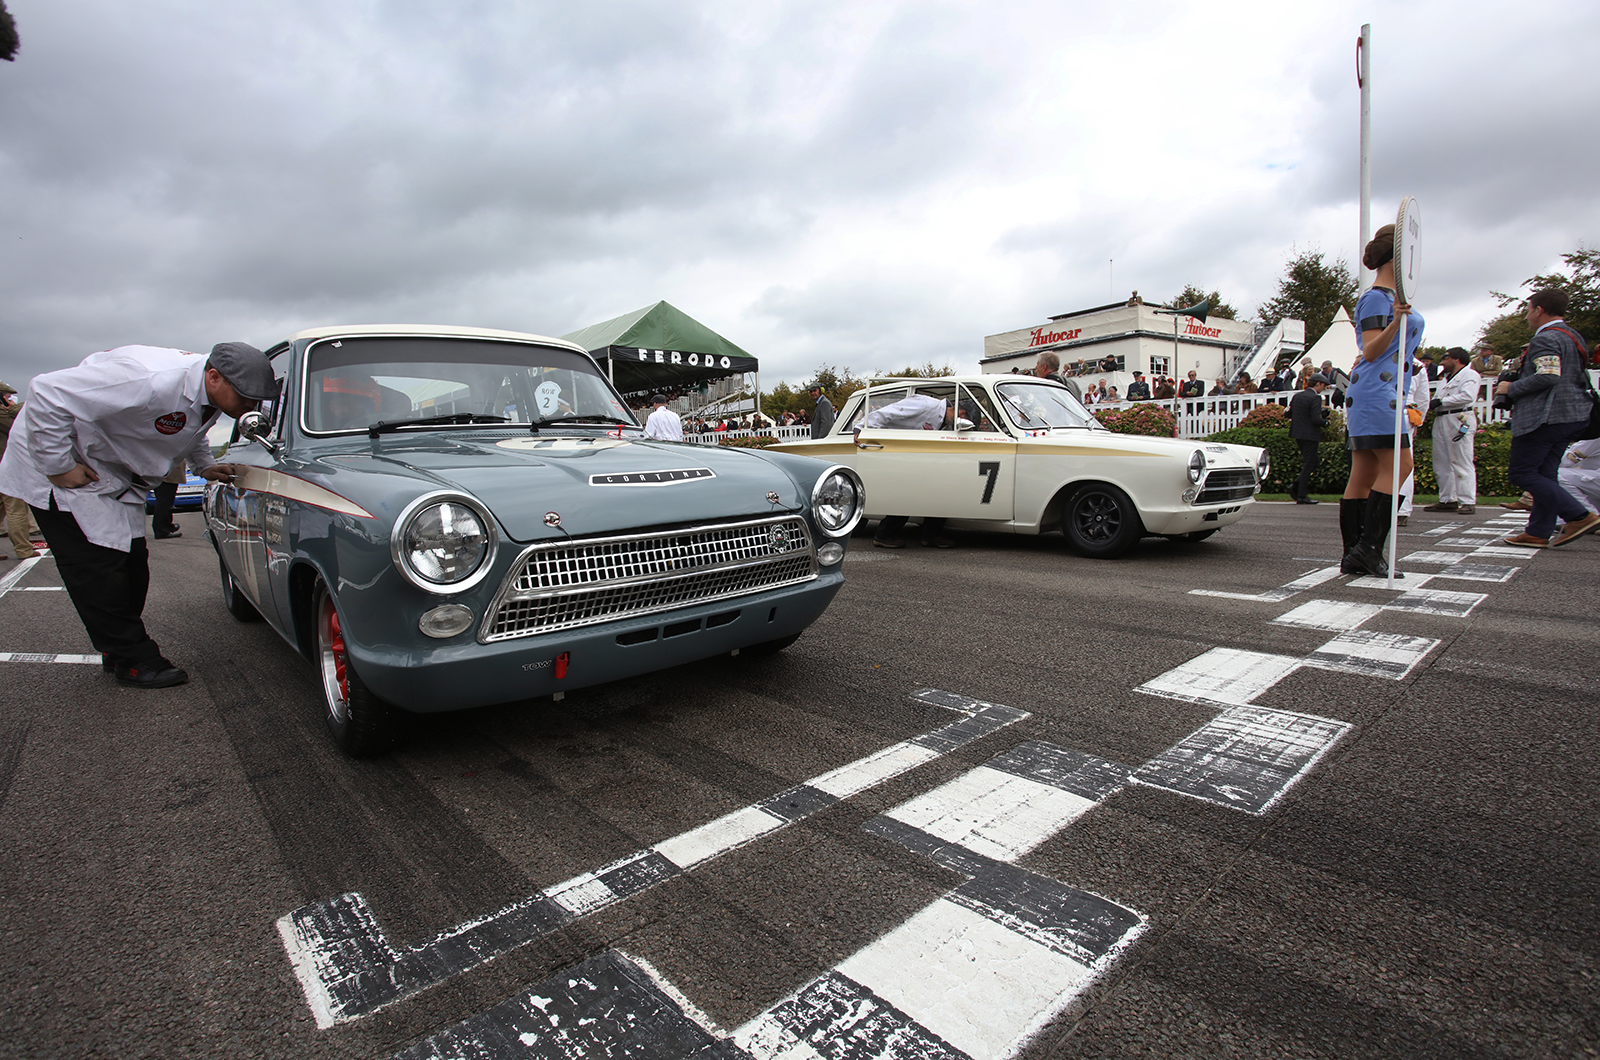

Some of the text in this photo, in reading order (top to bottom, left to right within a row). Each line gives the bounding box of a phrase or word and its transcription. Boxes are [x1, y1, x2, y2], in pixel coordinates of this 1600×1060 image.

[1408, 245, 1414, 280] 1
[1183, 316, 1222, 338] Autocar
[1028, 327, 1082, 347] Autocar
[638, 348, 731, 369] FERODO
[541, 387, 556, 395] ROW
[543, 397, 550, 408] 2
[159, 417, 184, 428] MOTUL
[606, 470, 702, 483] CORTINA
[978, 461, 1001, 504] 7
[521, 659, 552, 671] TOW
